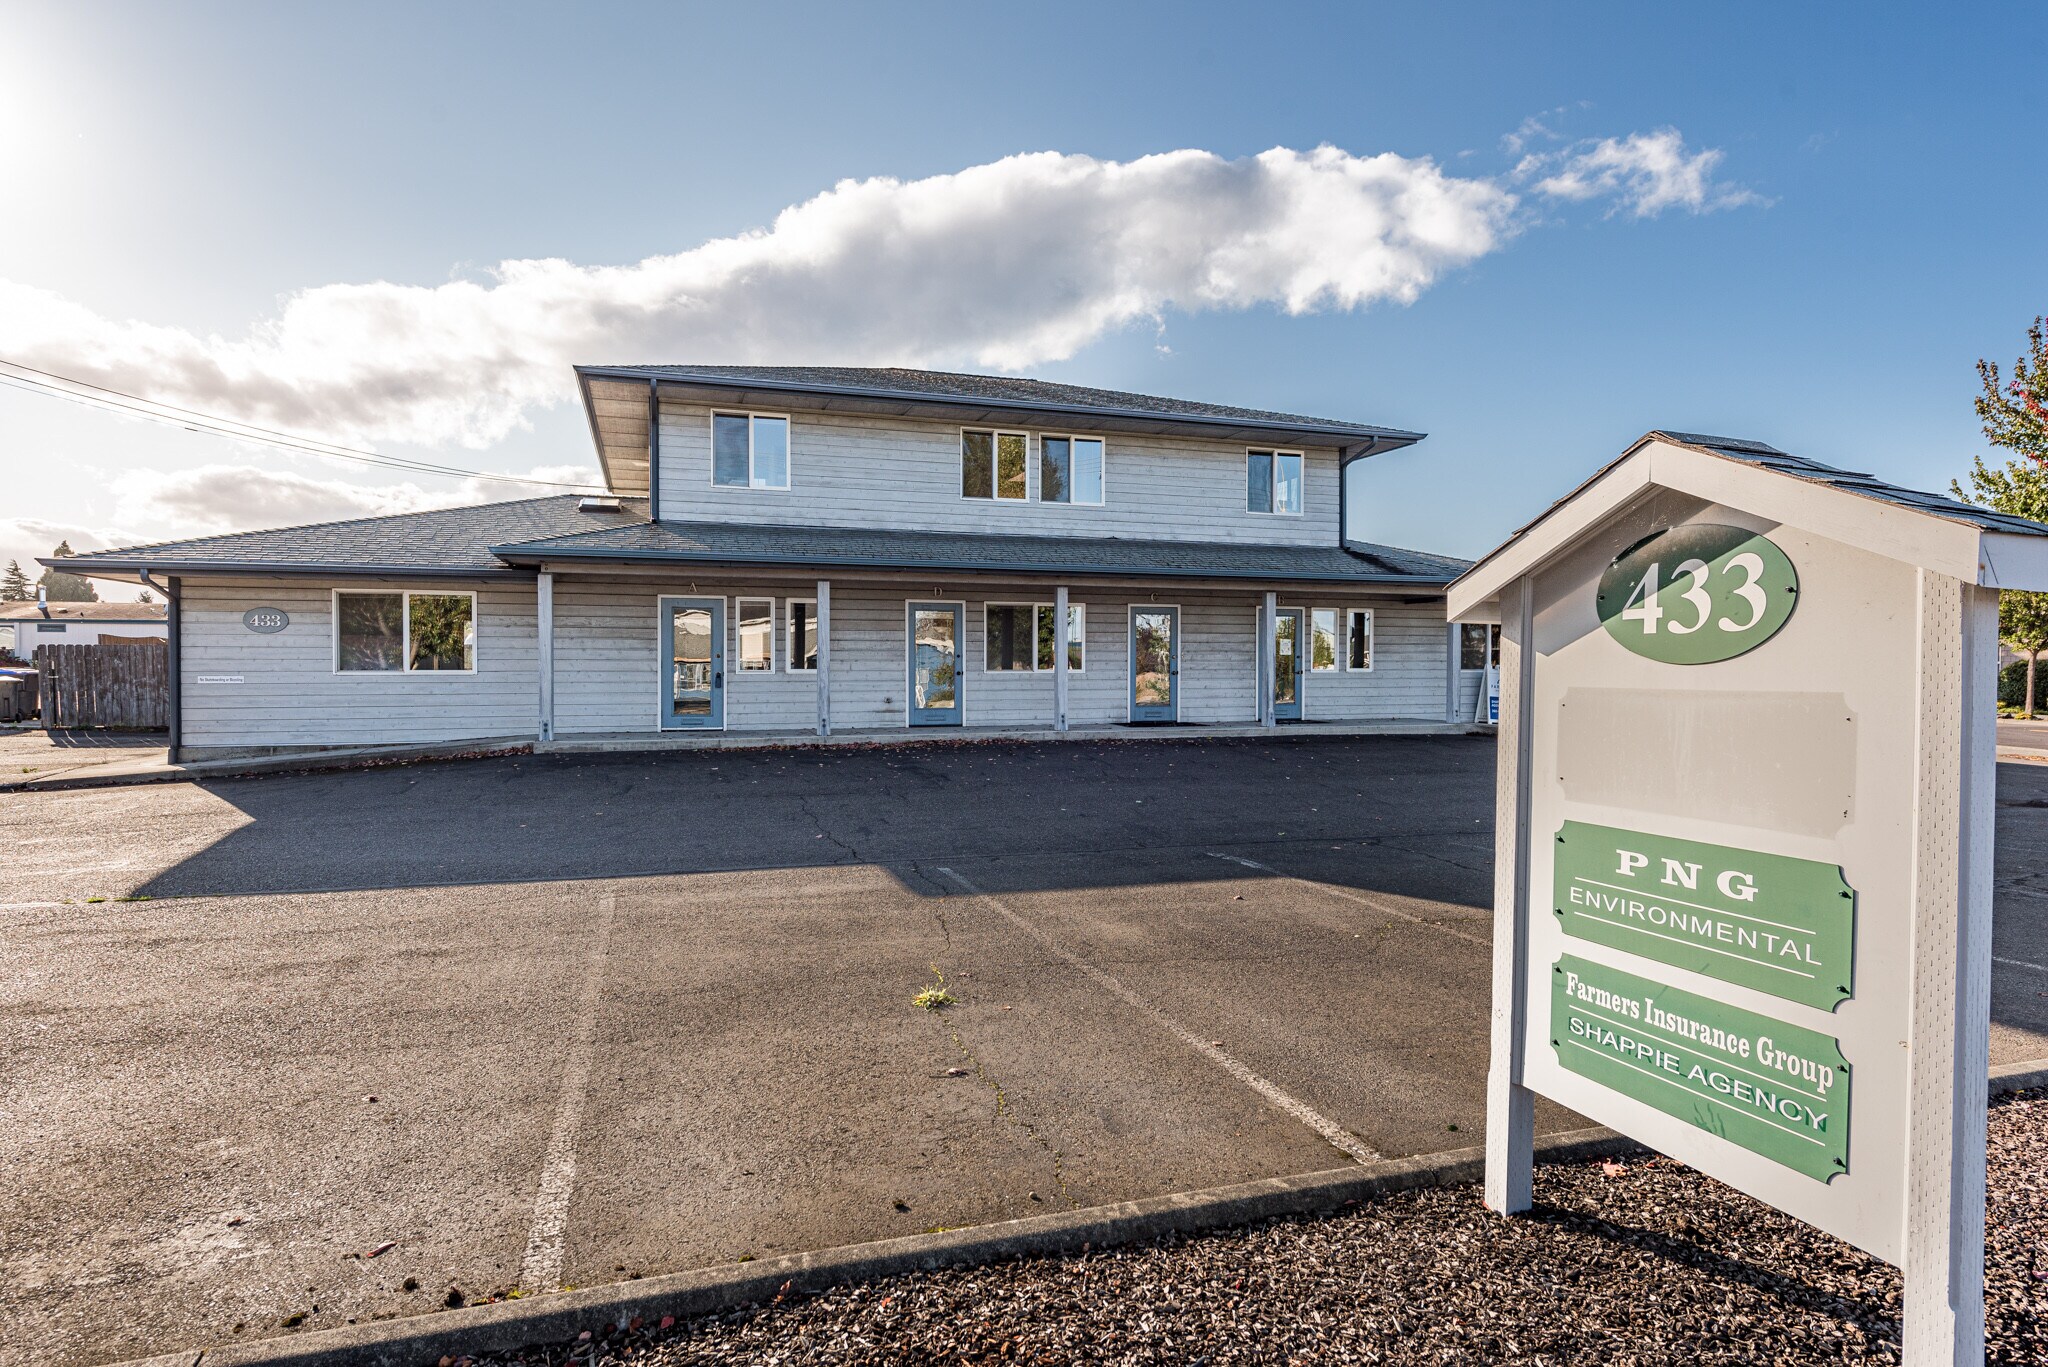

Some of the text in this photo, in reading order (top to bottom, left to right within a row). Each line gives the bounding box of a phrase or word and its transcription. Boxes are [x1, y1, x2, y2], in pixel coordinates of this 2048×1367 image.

[688, 582, 698, 593] A
[933, 586, 943, 597] D
[1150, 592, 1159, 602] C
[1621, 552, 1768, 635] 433
[249, 614, 281, 627] 433
[1569, 886, 1822, 966] ENVIRONMENTAL
[1566, 970, 1834, 1094] Farmers Insurance Group
[1569, 1017, 1829, 1131] SHAPPIE AGENCY
